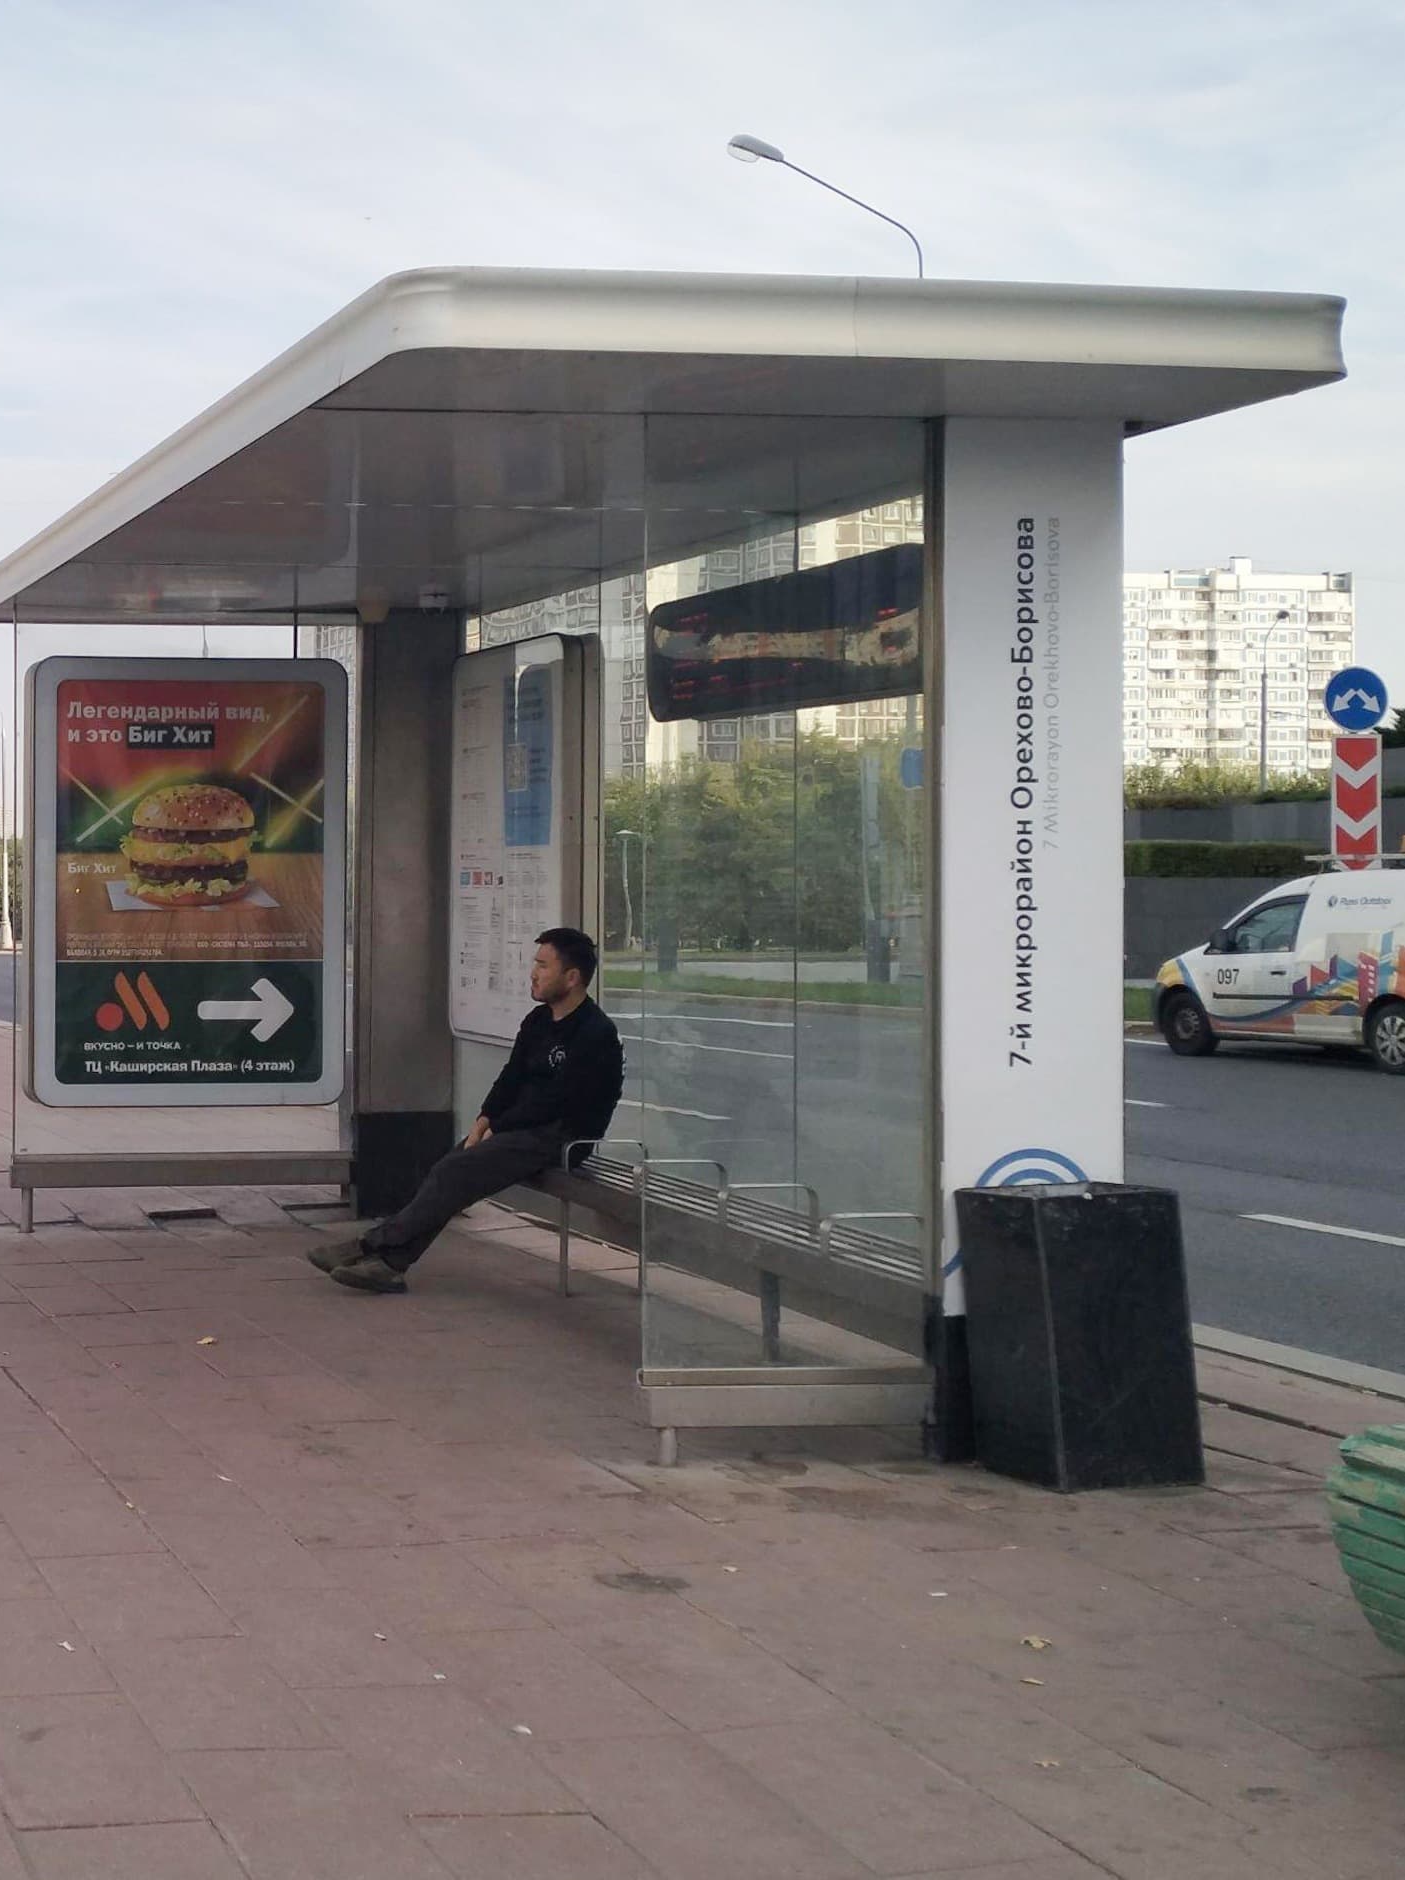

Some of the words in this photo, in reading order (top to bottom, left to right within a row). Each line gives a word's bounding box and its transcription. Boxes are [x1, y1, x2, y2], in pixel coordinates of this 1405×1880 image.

[1043, 517, 1060, 708] Orekhovo-Borisova
[1010, 518, 1039, 809] Орехово-Борисова
[67, 701, 219, 722] Легендарный
[226, 706, 271, 722] вид,
[68, 730, 80, 742] и
[86, 730, 122, 742] это
[128, 726, 167, 743] Биг
[172, 726, 213, 743] Хит
[1043, 715, 1062, 833] Mikrorayon
[1043, 839, 1059, 849] 7
[68, 862, 90, 873] Биг
[93, 862, 116, 873] Хит
[1010, 820, 1038, 1013] микрорайон
[1217, 968, 1240, 984] 097
[83, 1042, 125, 1050] ВКУСНО
[136, 1042, 143, 1050] И
[146, 1042, 181, 1050] ТОЧКА
[1009, 1023, 1033, 1067] 7-й
[85, 1061, 102, 1074] ТЦ
[241, 1060, 253, 1073] (4
[256, 1060, 295, 1073] этаж)
